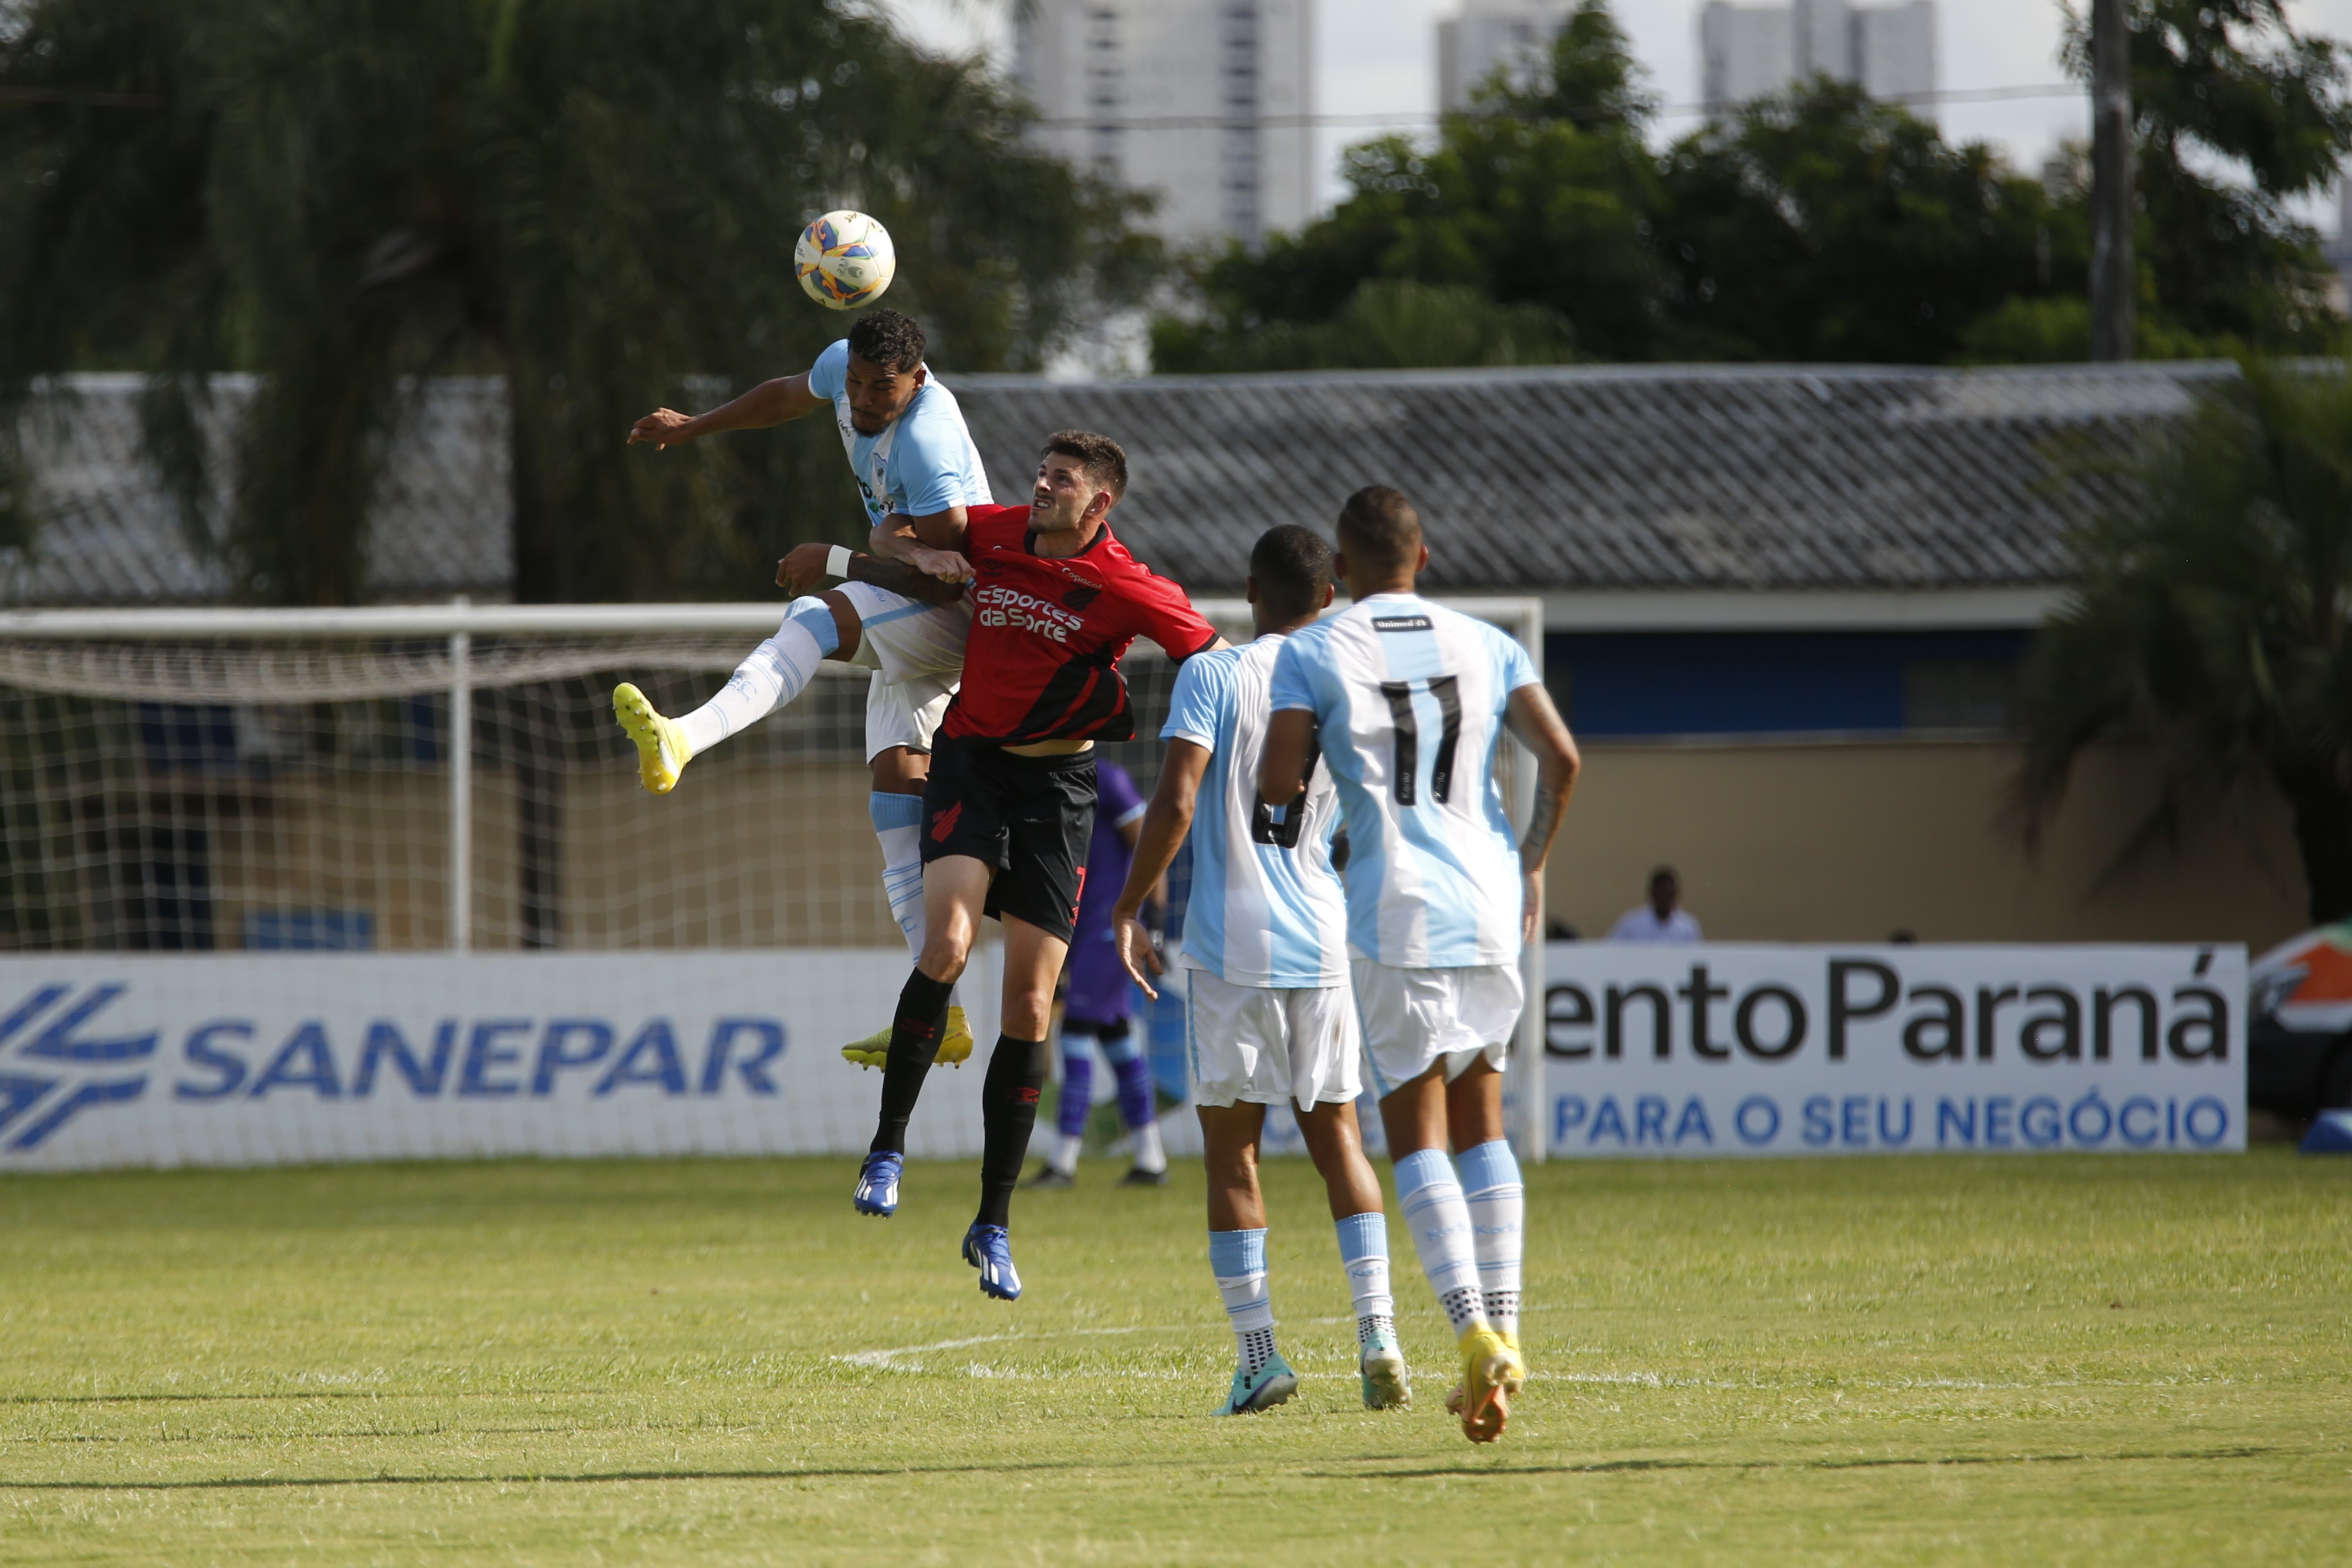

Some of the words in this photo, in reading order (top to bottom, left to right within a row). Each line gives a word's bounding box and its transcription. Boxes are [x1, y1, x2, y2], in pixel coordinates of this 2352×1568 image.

[1376, 619, 1414, 628] Unimed
[1401, 772, 1411, 799] Karilu
[1545, 961, 1809, 1064] ento
[1827, 947, 2229, 1065] Paraná
[173, 1017, 789, 1104] SANEPAR
[1556, 1096, 1712, 1146] PARA
[1735, 1096, 1780, 1147] O
[1803, 1096, 1914, 1147] SEU
[1938, 1083, 2229, 1147] NEGÓCIO
